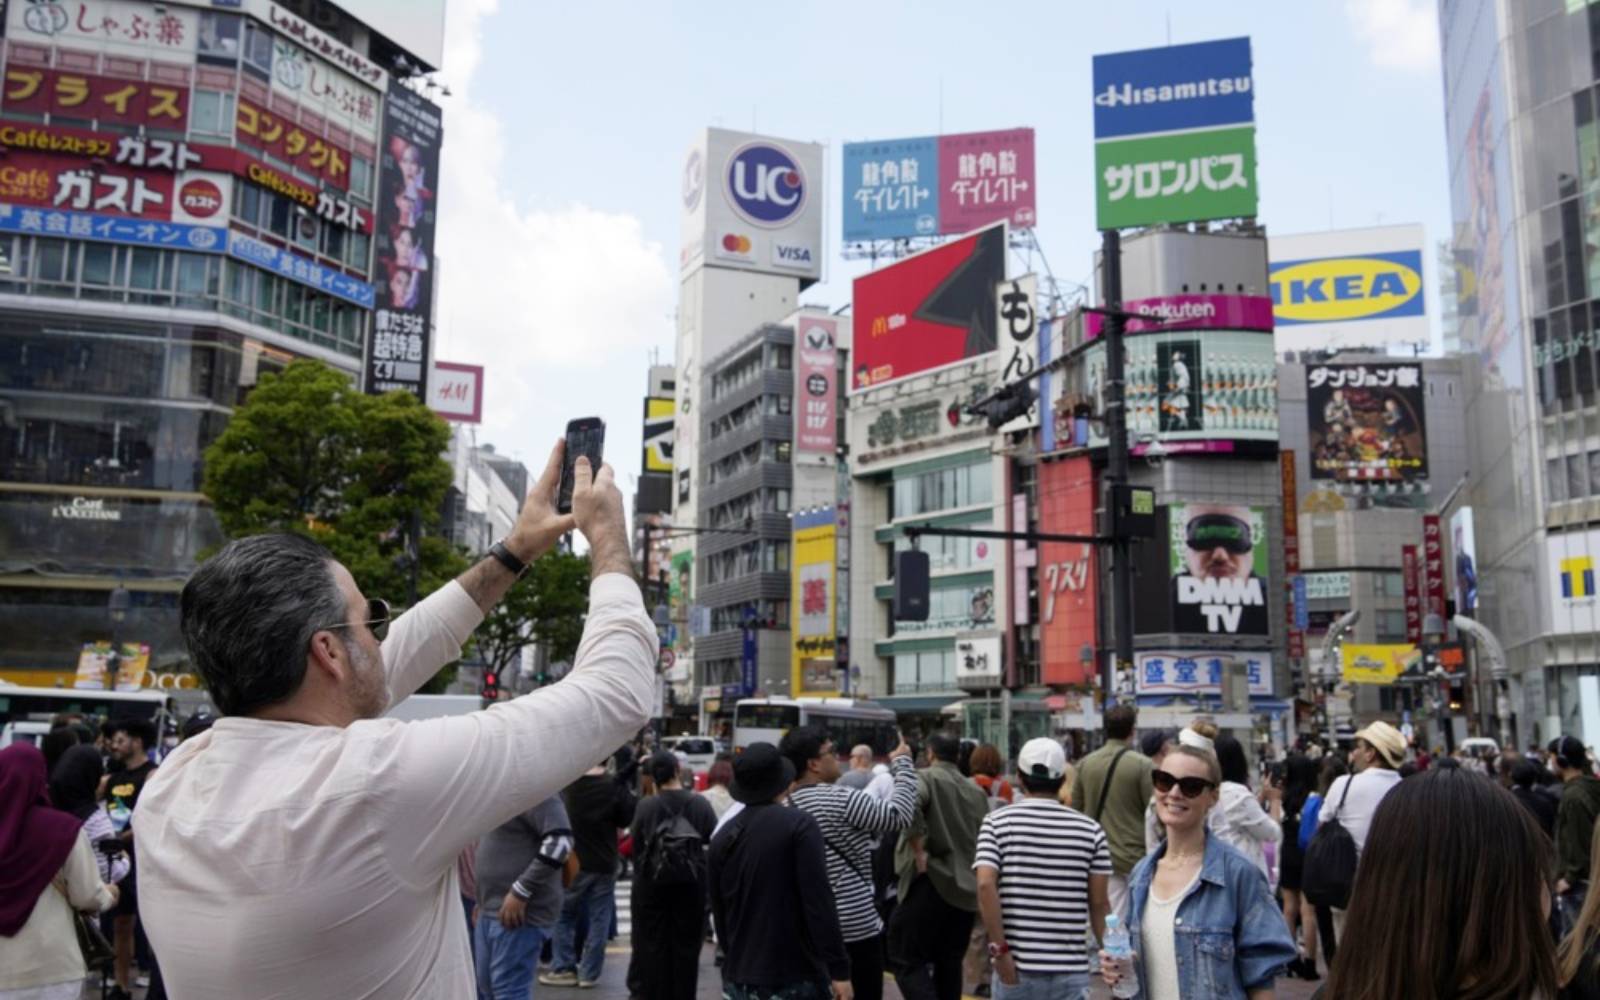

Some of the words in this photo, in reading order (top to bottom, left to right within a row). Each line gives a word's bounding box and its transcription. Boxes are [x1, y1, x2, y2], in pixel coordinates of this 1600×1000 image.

[76, 4, 184, 45] しゃぶ葉
[7, 71, 182, 119] プライス
[309, 66, 373, 124] しゃぶ葉
[1095, 75, 1251, 107] Hisamitsu
[115, 136, 201, 170] ガスト
[237, 103, 346, 176] コンタクト
[53, 169, 164, 214] ガスト
[733, 160, 799, 206] UC
[951, 176, 1029, 206] ダイレクト
[1103, 152, 1248, 201] サロンパス
[316, 191, 366, 230] ガスト
[854, 184, 931, 214] ダイレクト
[20, 208, 181, 243] 英会話イーオン
[777, 244, 811, 262] VISA
[279, 251, 372, 304] 英会話イーオン
[1269, 271, 1408, 305] IKEA
[1177, 576, 1264, 605] DMM
[1201, 605, 1242, 633] TV
